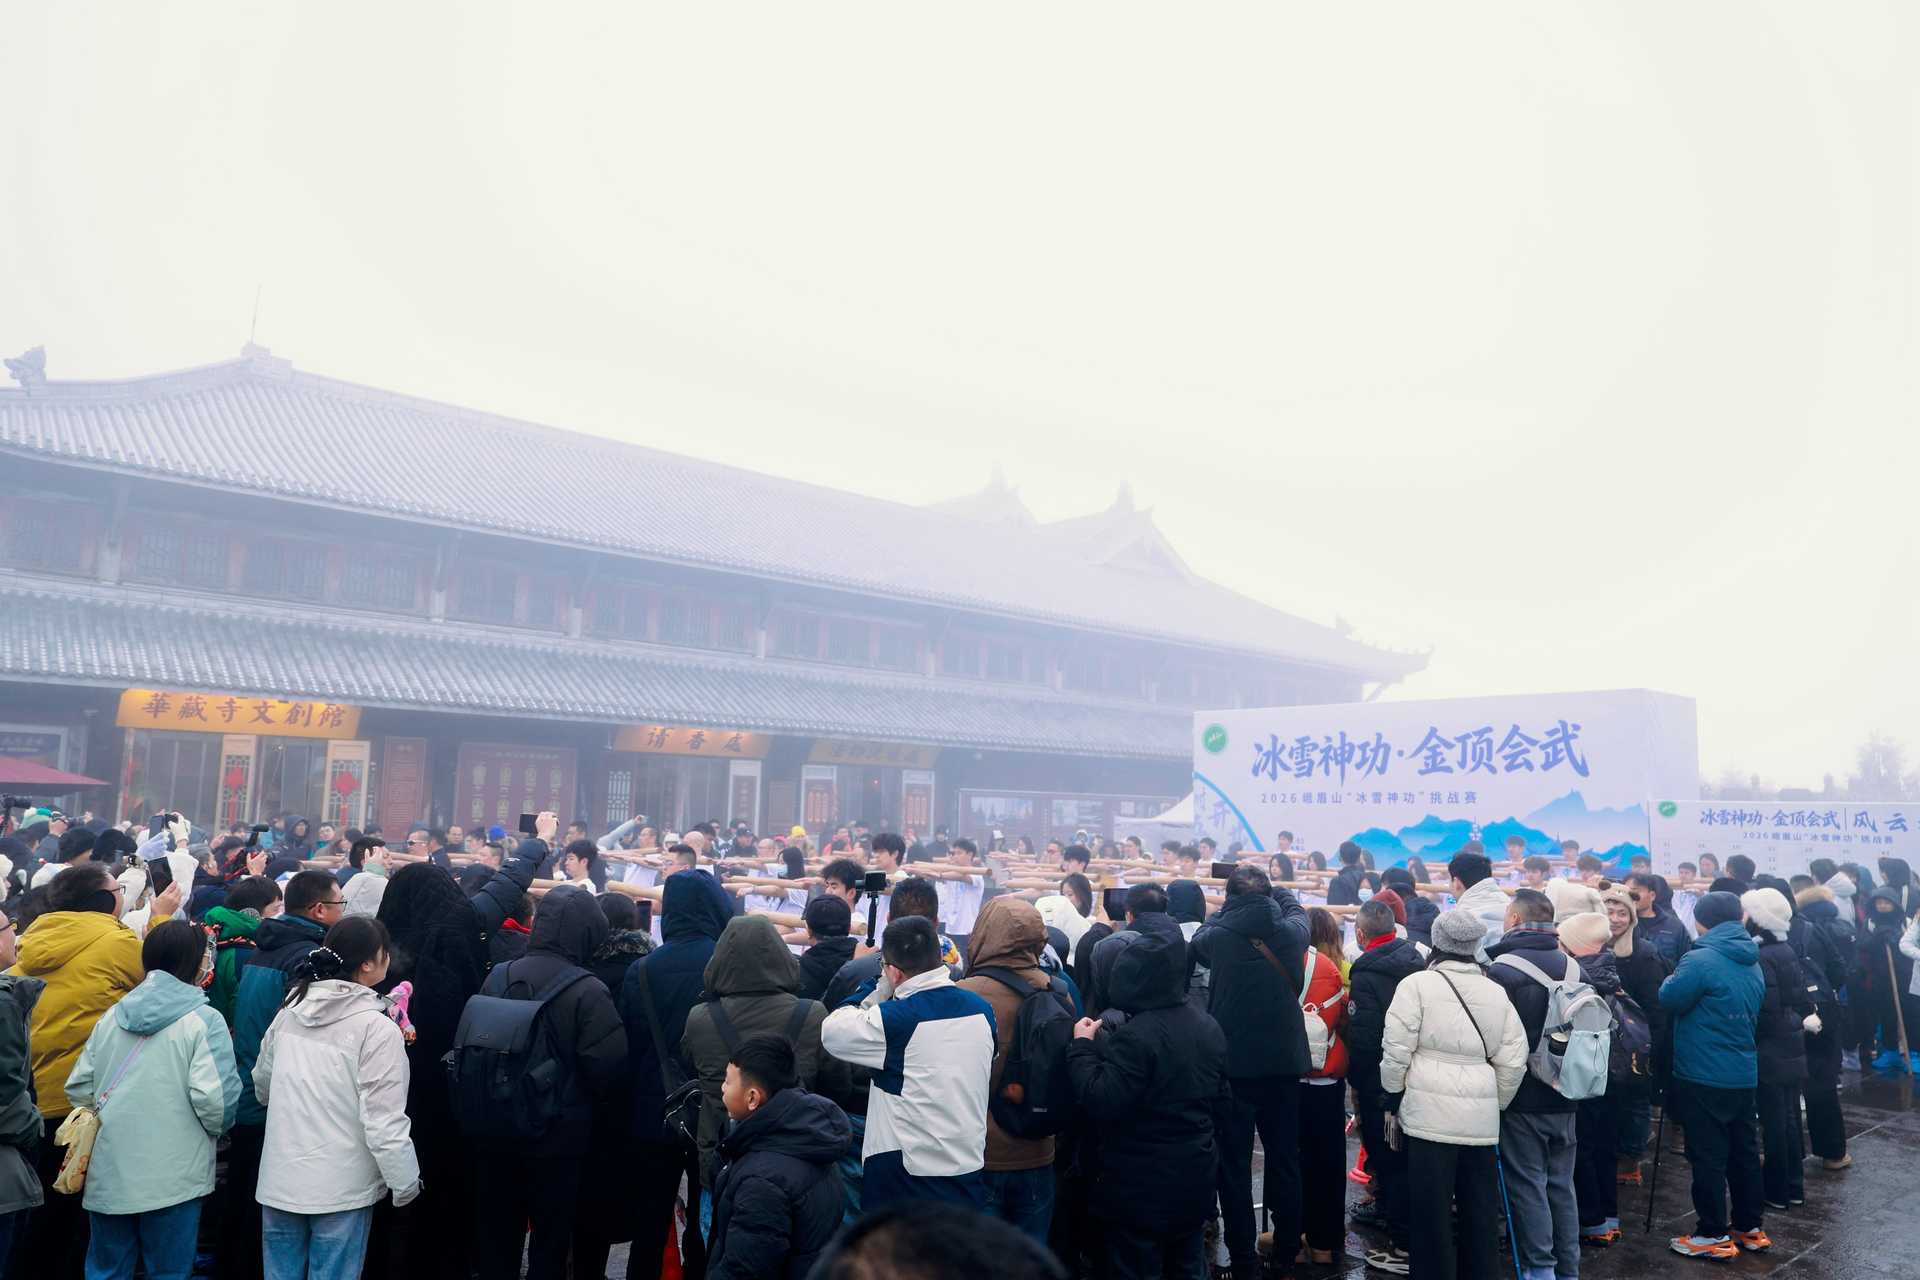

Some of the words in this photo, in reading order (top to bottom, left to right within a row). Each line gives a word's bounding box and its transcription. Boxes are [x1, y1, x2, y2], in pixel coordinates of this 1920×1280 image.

[1251, 720, 1590, 787] 冰雪神功·金顶会武
[1853, 810, 1920, 833] 风云
